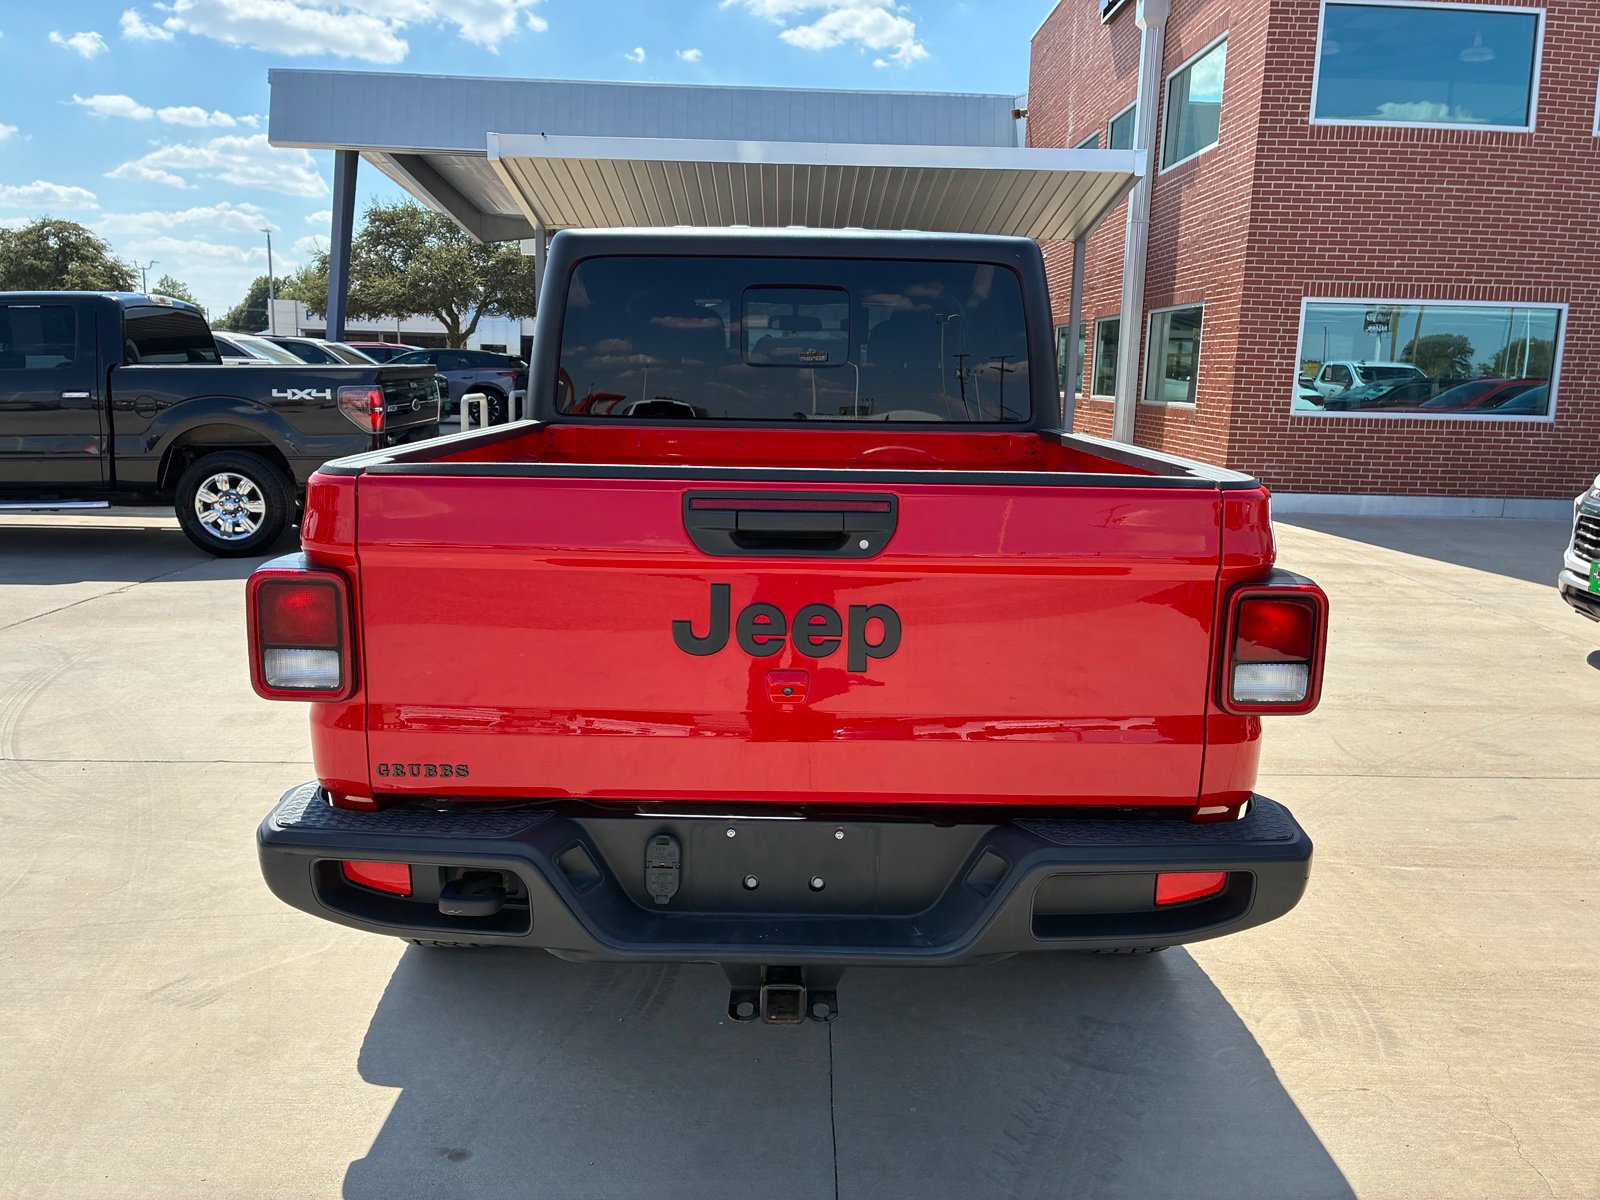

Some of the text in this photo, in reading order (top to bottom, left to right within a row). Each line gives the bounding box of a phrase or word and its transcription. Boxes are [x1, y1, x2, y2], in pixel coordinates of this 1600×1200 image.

[272, 388, 332, 400] 4X4
[672, 583, 902, 673] Jeep
[376, 763, 470, 778] GRUBBS
